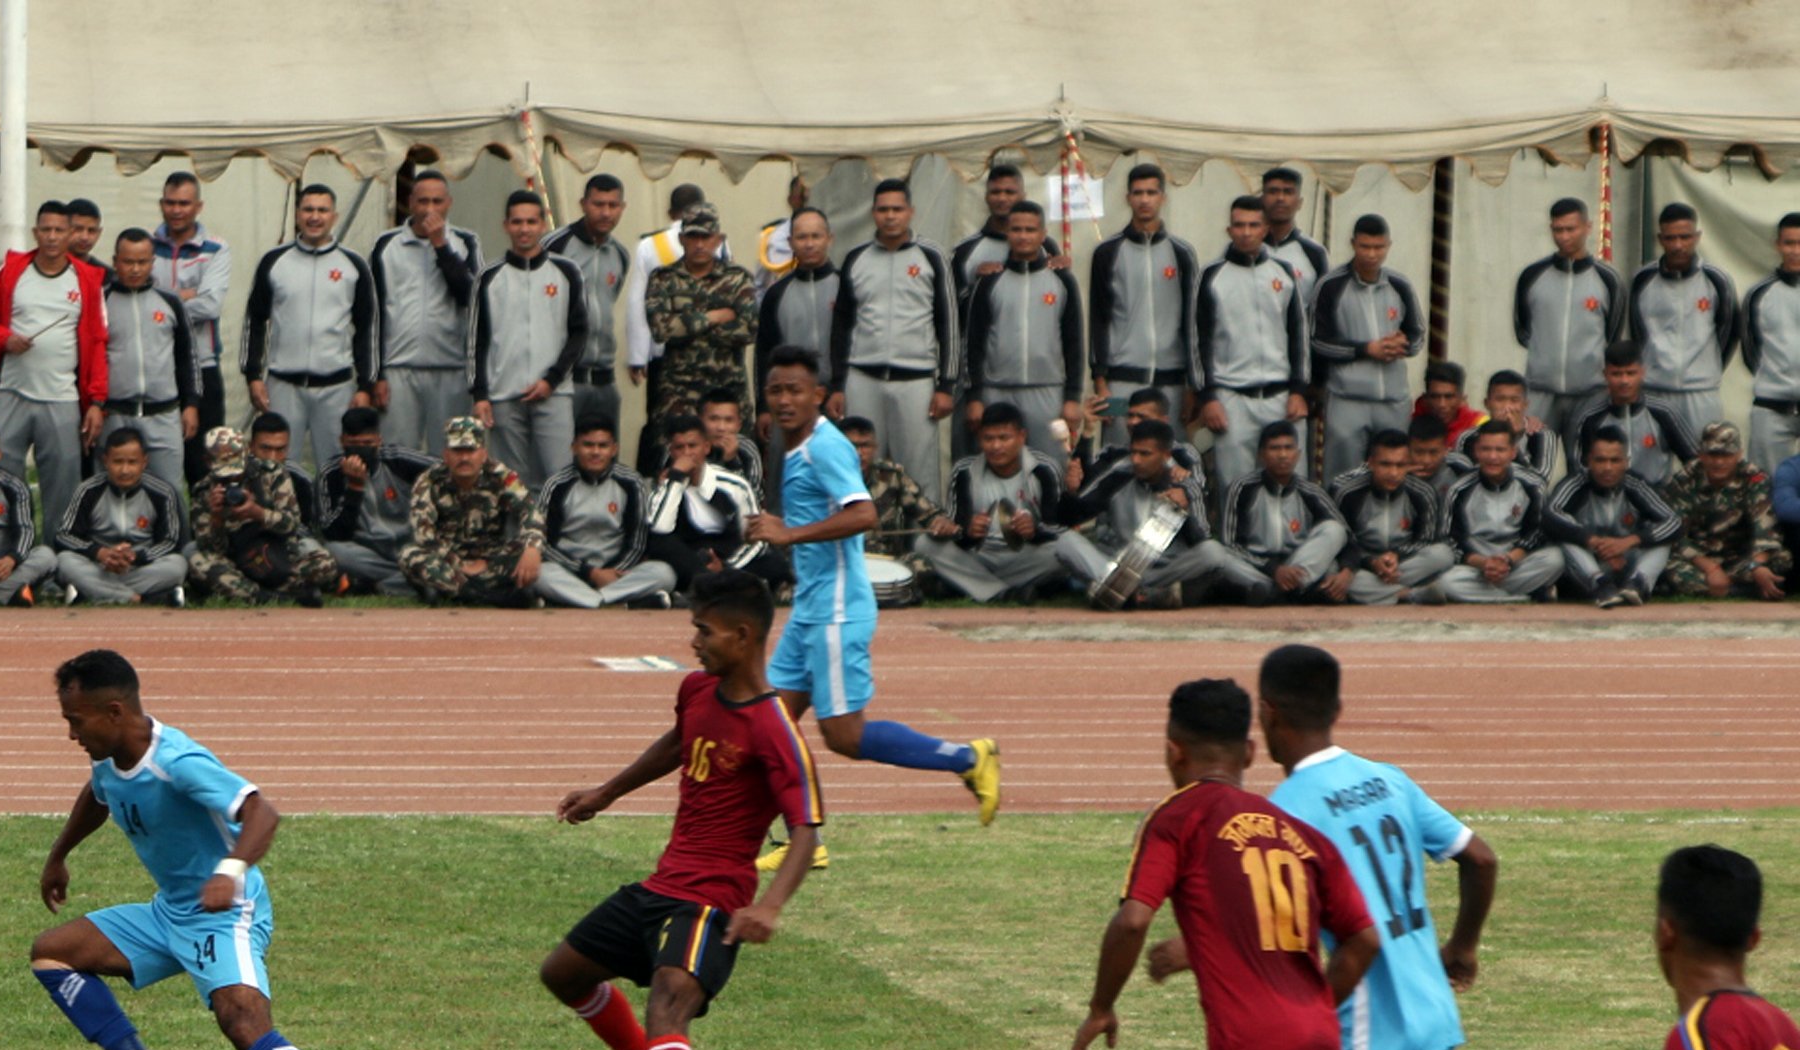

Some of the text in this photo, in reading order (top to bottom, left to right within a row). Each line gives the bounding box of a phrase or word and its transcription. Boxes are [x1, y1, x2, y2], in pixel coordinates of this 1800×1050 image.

[687, 736, 717, 782] 16
[120, 801, 149, 837] 14
[1242, 846, 1309, 952] 10
[1349, 814, 1426, 940] 12
[193, 933, 217, 971] 14
